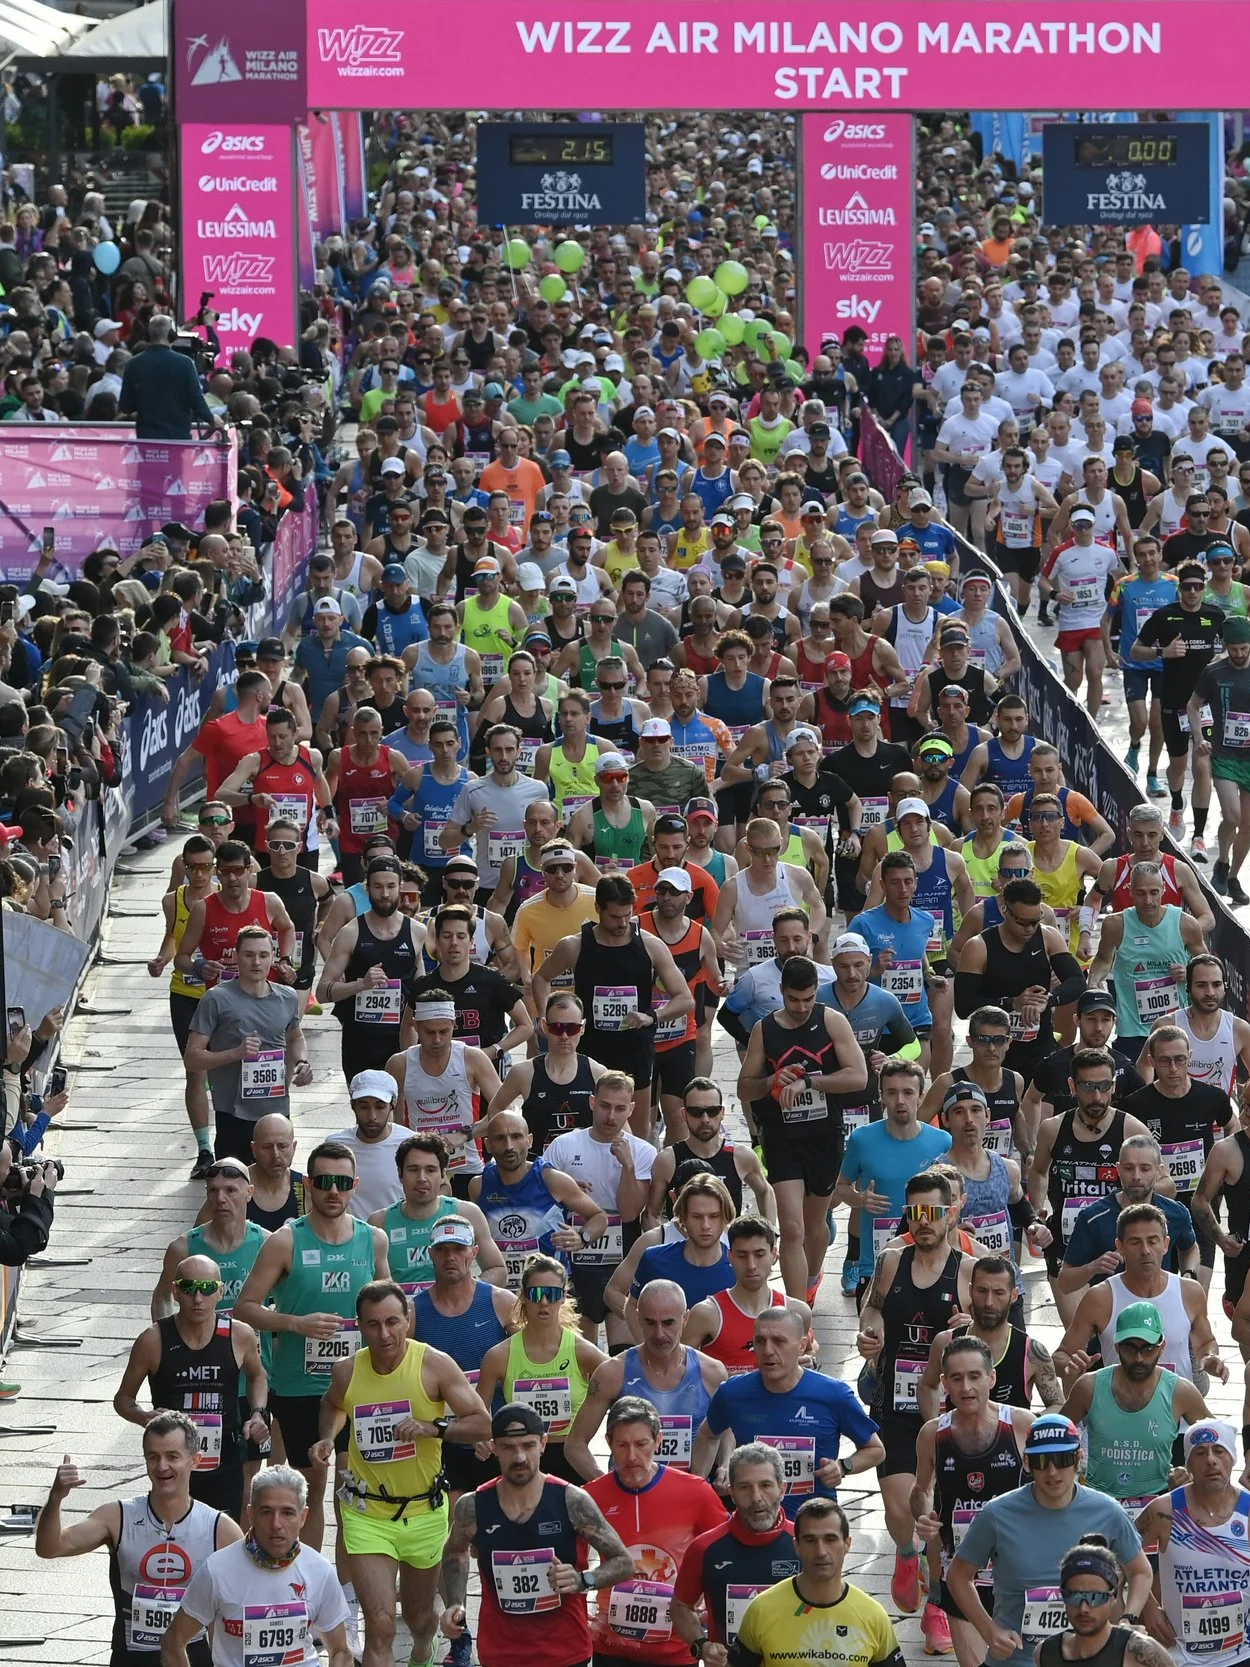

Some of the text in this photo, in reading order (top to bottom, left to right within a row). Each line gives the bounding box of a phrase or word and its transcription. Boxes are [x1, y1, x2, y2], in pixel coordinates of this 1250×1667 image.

[516, 20, 1162, 54] WIZZ AIR MILANO MARATHON
[245, 51, 298, 60] WIZZ AIR
[245, 61, 298, 71] MILANO
[337, 66, 405, 77] wizzair.com
[245, 72, 298, 80] MARATHON
[773, 67, 907, 99] START
[838, 164, 898, 180] UniCredit
[216, 175, 278, 192] UniCredit
[521, 193, 602, 210] FESTINA
[1086, 193, 1167, 210] FESTINA
[818, 208, 896, 226] LEVISSIMA
[198, 219, 275, 238] LEVISSIMA
[839, 272, 894, 282] wizzair.com
[219, 286, 275, 295] wizzair.com
[836, 295, 881, 323] sky
[216, 307, 263, 337] sky
[1078, 590, 1091, 598] 1853
[1234, 726, 1248, 736] 826
[891, 977, 914, 990] 2354
[366, 996, 390, 1009] 2942
[1147, 994, 1170, 1008] 1008
[603, 1004, 628, 1017] 5289
[253, 1070, 277, 1083] 3586
[1057, 1159, 1119, 1168] TRIATHLON
[1170, 1160, 1196, 1176] 2698
[322, 1271, 350, 1288] DKR
[318, 1342, 349, 1356] 2205
[189, 1366, 220, 1380] MET
[1033, 1428, 1065, 1440] SWATT
[1114, 1440, 1141, 1448] A.S.D.
[1101, 1447, 1154, 1461] PODISTICA
[1174, 1568, 1250, 1580] ATLETICA
[514, 1575, 539, 1592] 382
[1176, 1579, 1249, 1592] TARANTO
[625, 1605, 657, 1624] 1888
[1199, 1617, 1230, 1635] 4199
[259, 1629, 293, 1648] 6793
[769, 1649, 869, 1663] www.wikaboo.com
